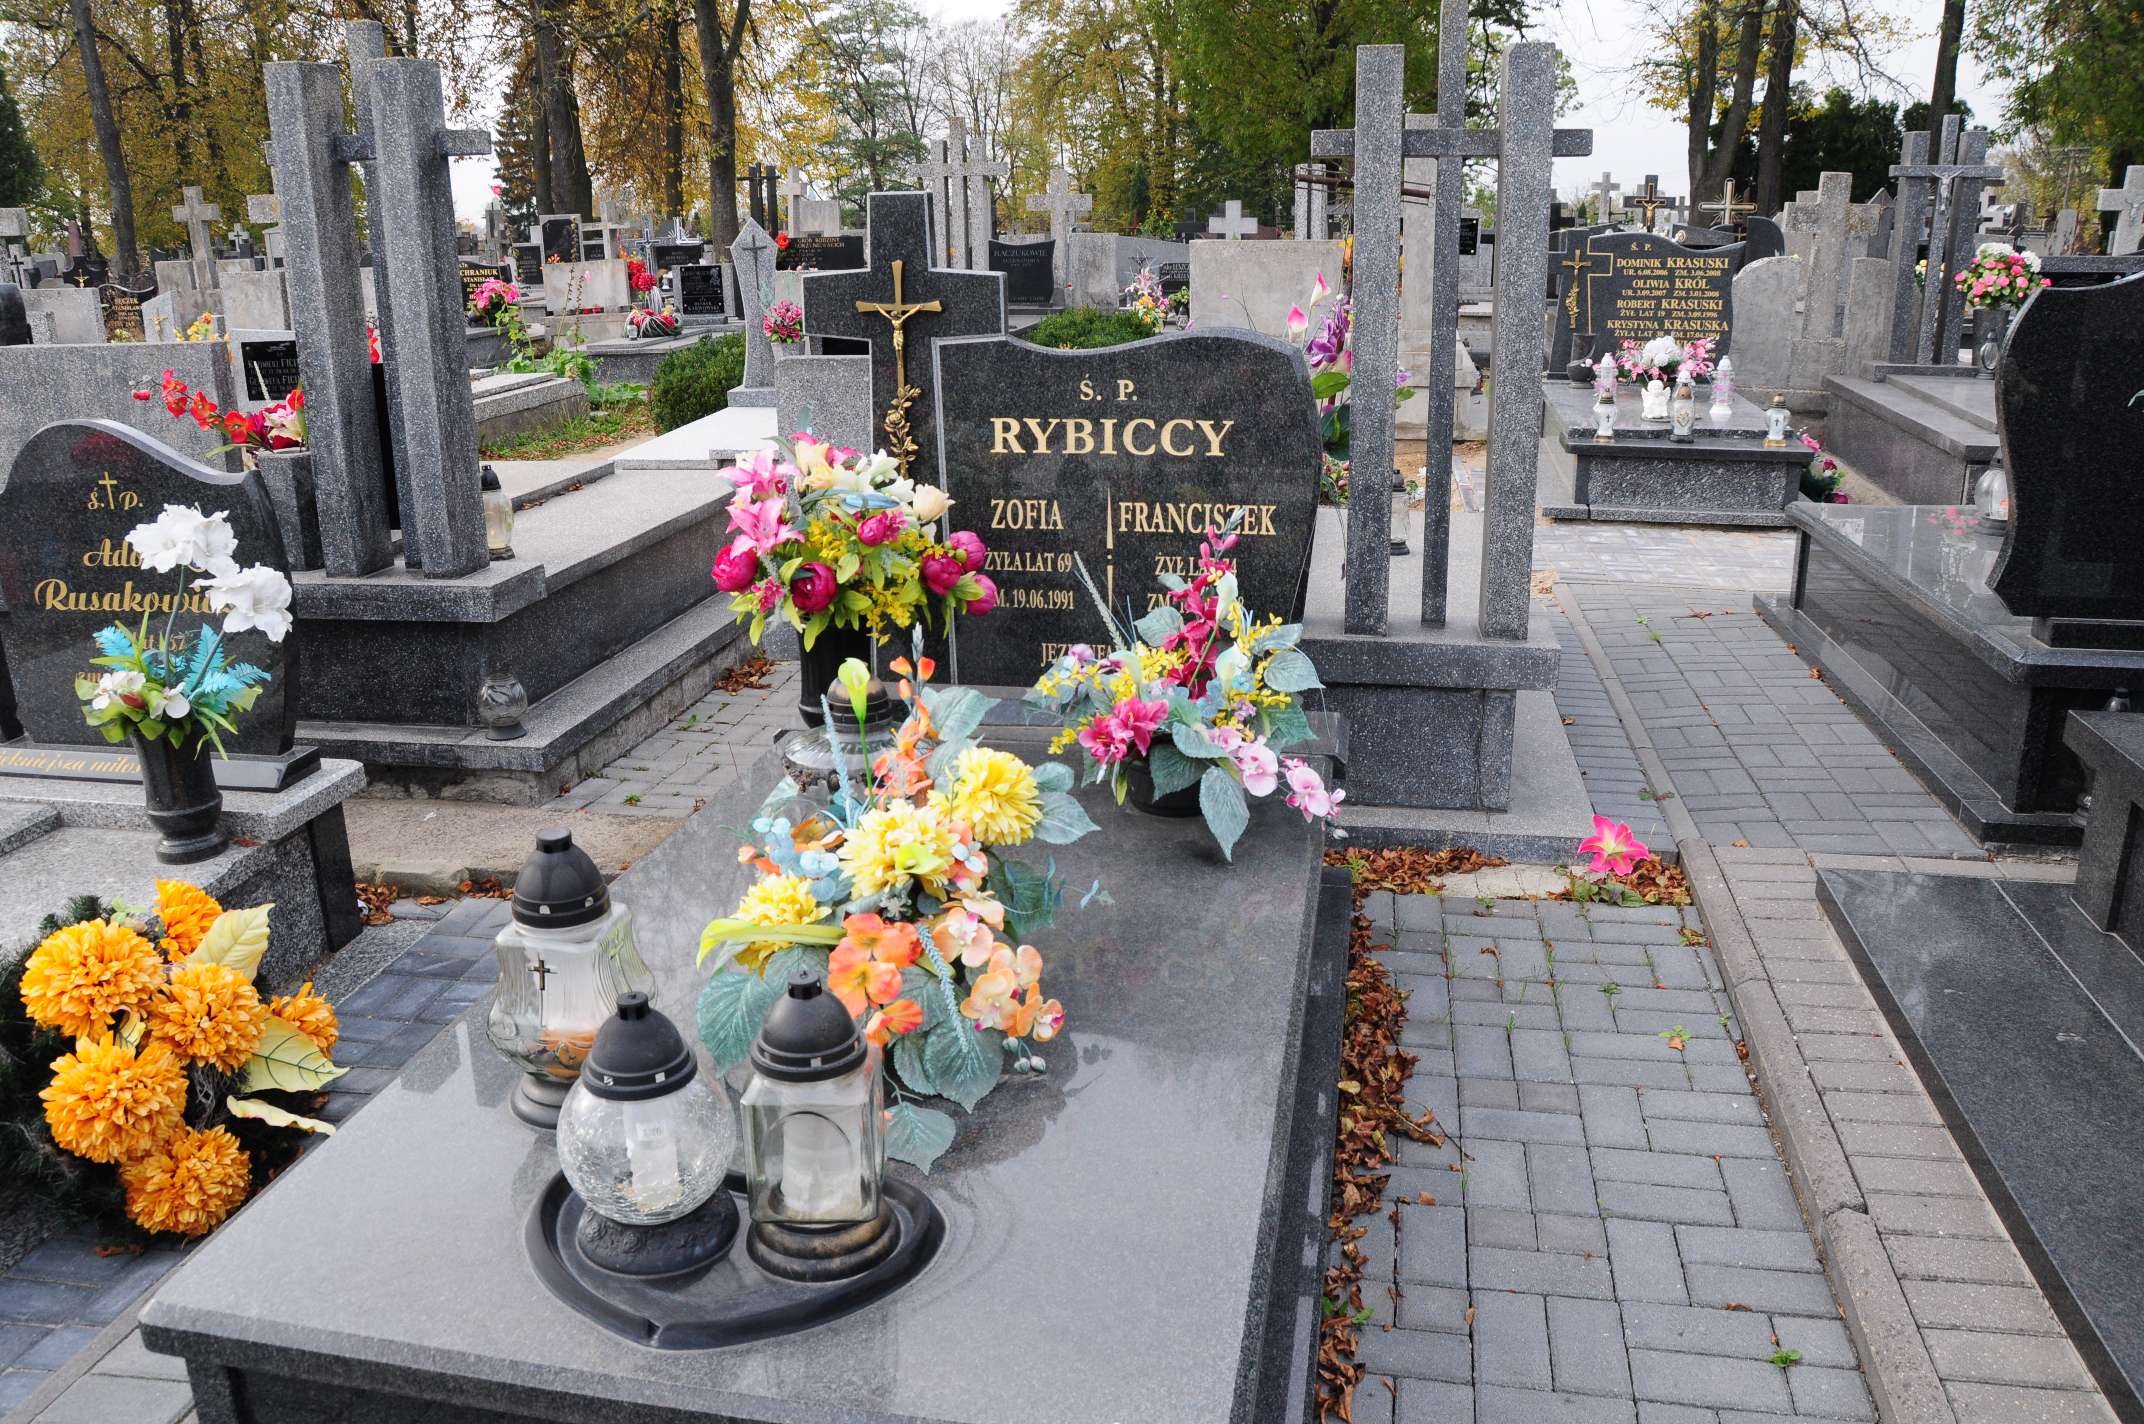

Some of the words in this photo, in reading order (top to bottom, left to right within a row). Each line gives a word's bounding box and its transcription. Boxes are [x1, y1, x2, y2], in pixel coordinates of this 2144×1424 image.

[1617, 258, 1662, 268] DOMINIK
[1667, 257, 1729, 269] KRASUSKI
[1632, 279, 1669, 289] OLIWIA
[1675, 276, 1710, 289] KRÓL
[1616, 299, 1656, 309] ROBERT
[1661, 299, 1723, 310] KRASUSKI
[1607, 320, 1659, 329] KRYSTYNA
[1664, 320, 1729, 331] KRASUSKA
[1079, 374, 1102, 401] Ś.
[1117, 379, 1138, 401] P.
[990, 417, 1234, 457] RYBICCY
[990, 498, 1064, 530] ZOFIA
[1118, 501, 1277, 536] FRANCISZEK
[984, 547, 1022, 571] ŻYŁA
[1025, 552, 1055, 572] LAT
[1057, 552, 1072, 573] 69
[1154, 552, 1185, 576] ŻYŁ
[1012, 589, 1074, 610] 19.06.1991
